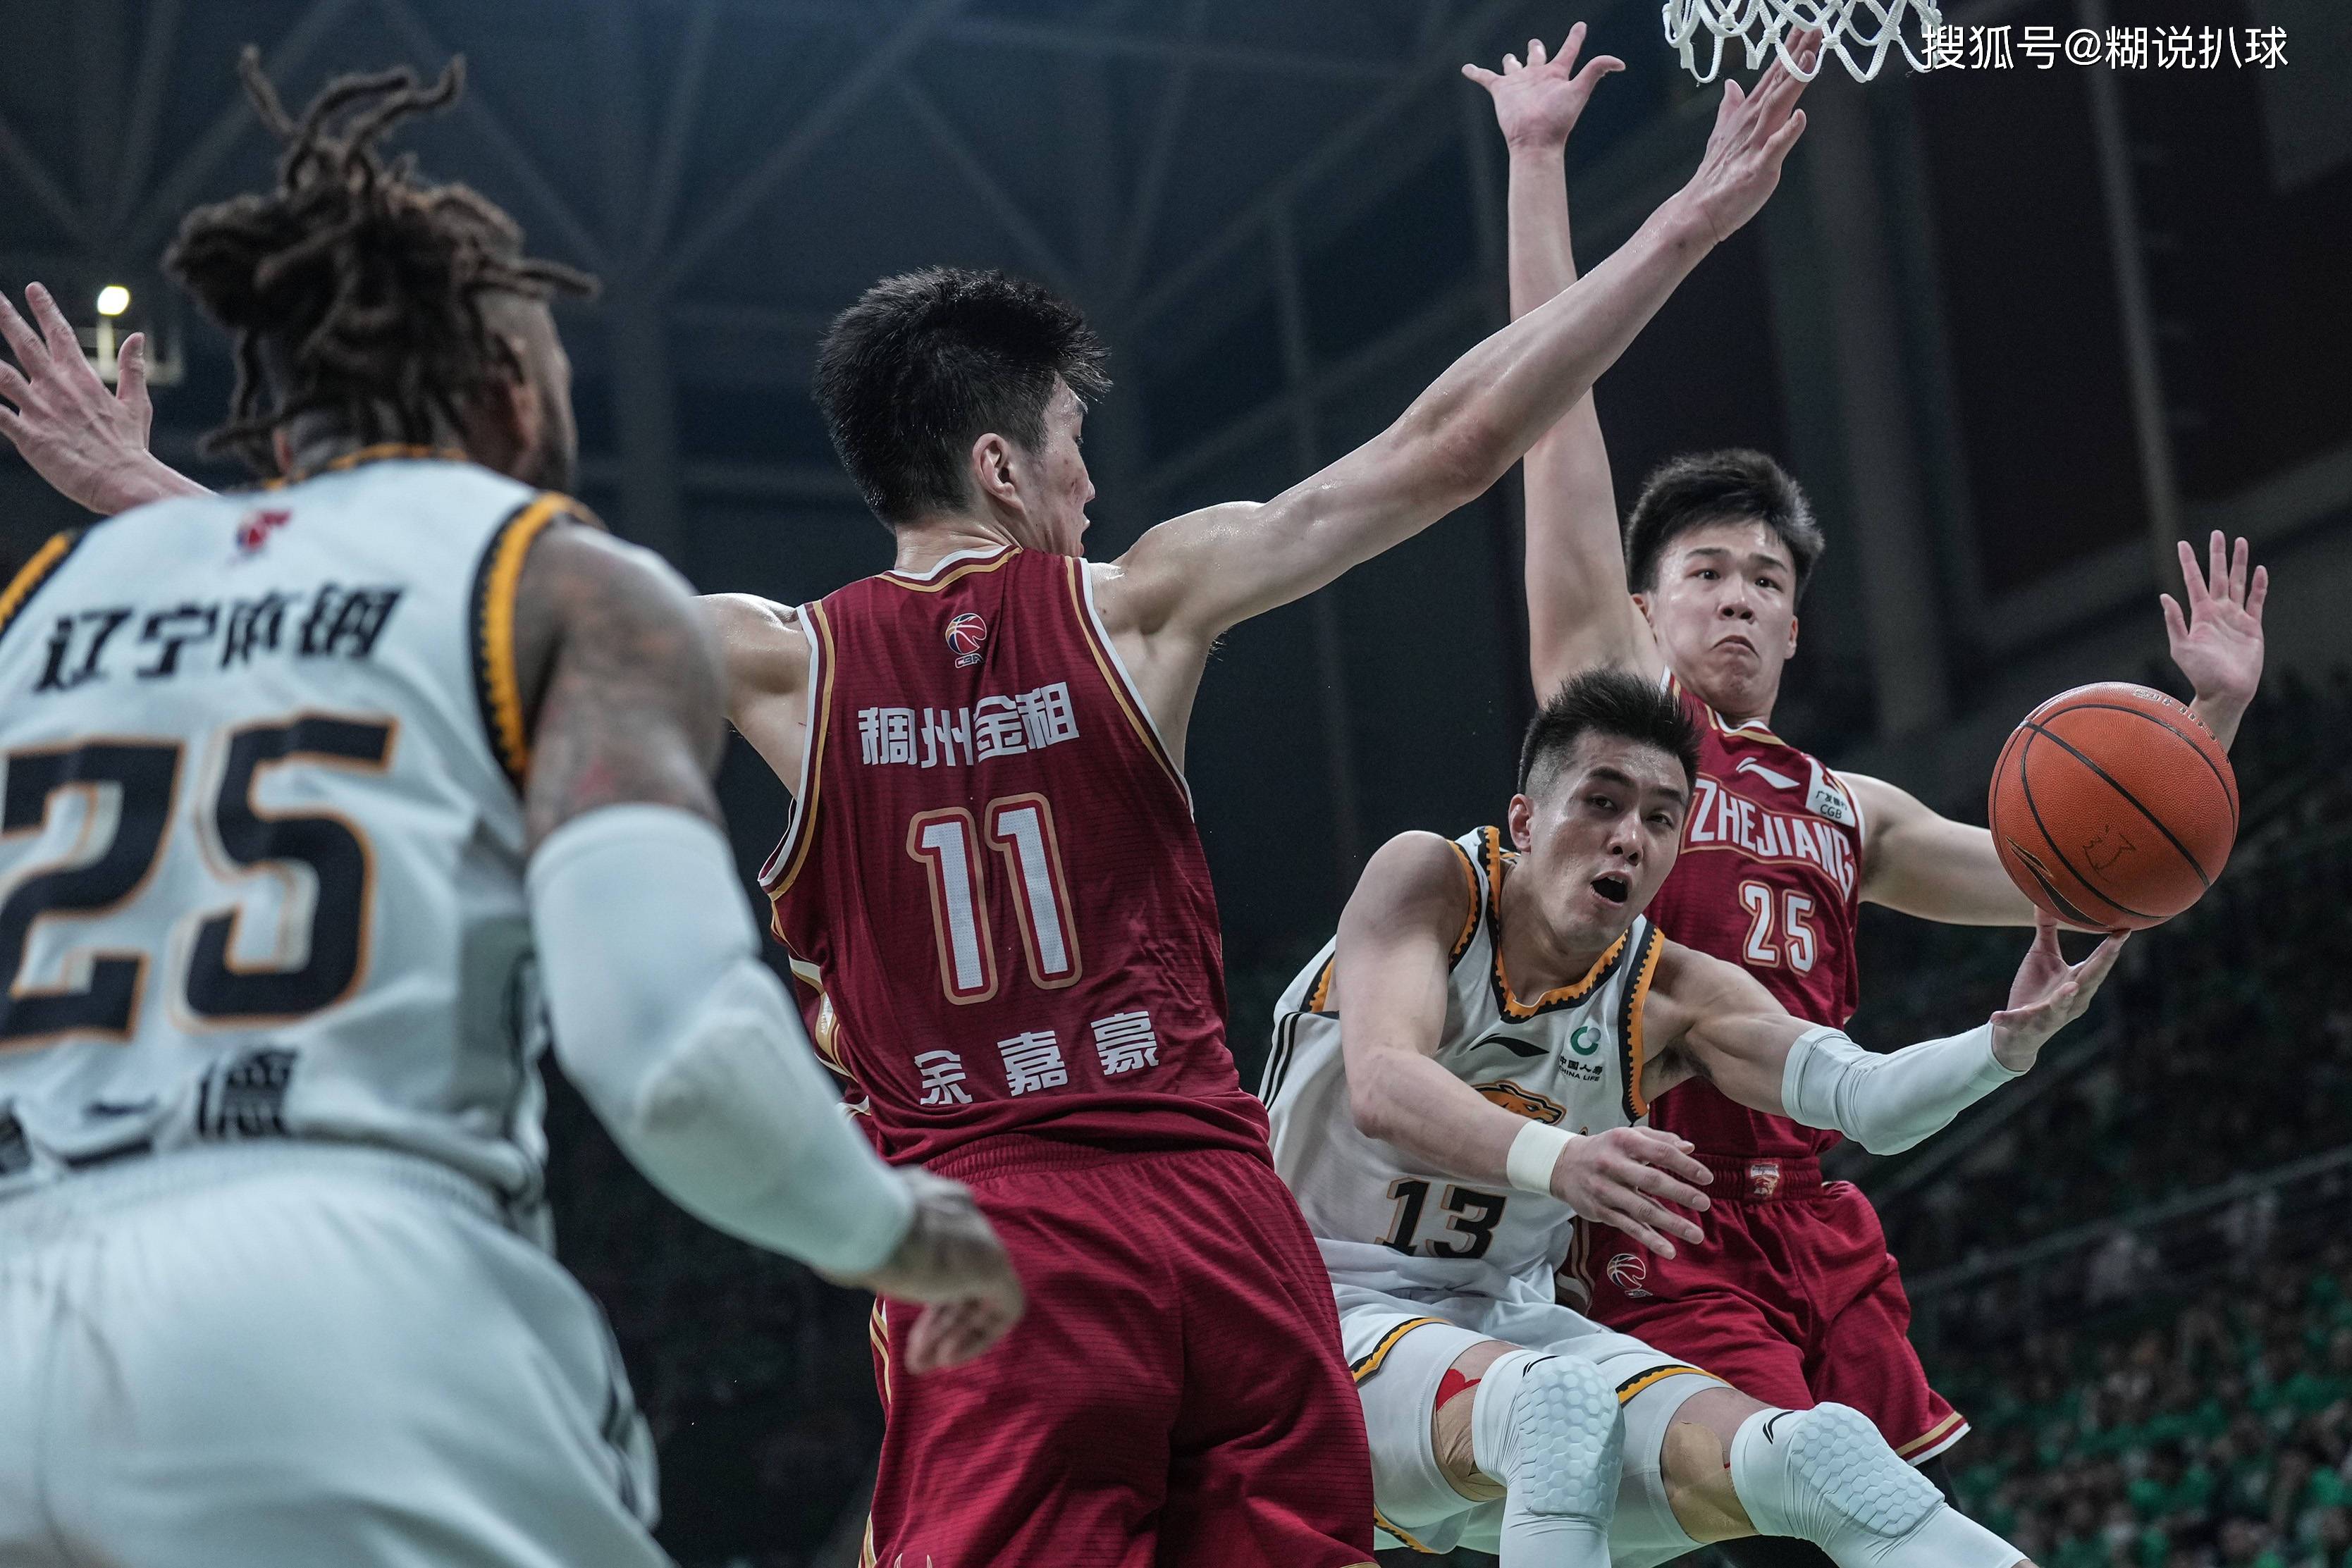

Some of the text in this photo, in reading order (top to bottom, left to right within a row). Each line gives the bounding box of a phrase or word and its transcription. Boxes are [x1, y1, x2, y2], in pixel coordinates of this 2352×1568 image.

[858, 681, 1080, 767] 稠州金租
[1820, 803, 1842, 819] CGB
[0, 711, 399, 1047] 25
[906, 792, 1082, 1005] 11
[1738, 879, 1818, 977] 25
[915, 1011, 1159, 1105] 余嘉豪
[1560, 1056, 1603, 1075] 中国人寿
[1374, 1175, 1508, 1259] 13
